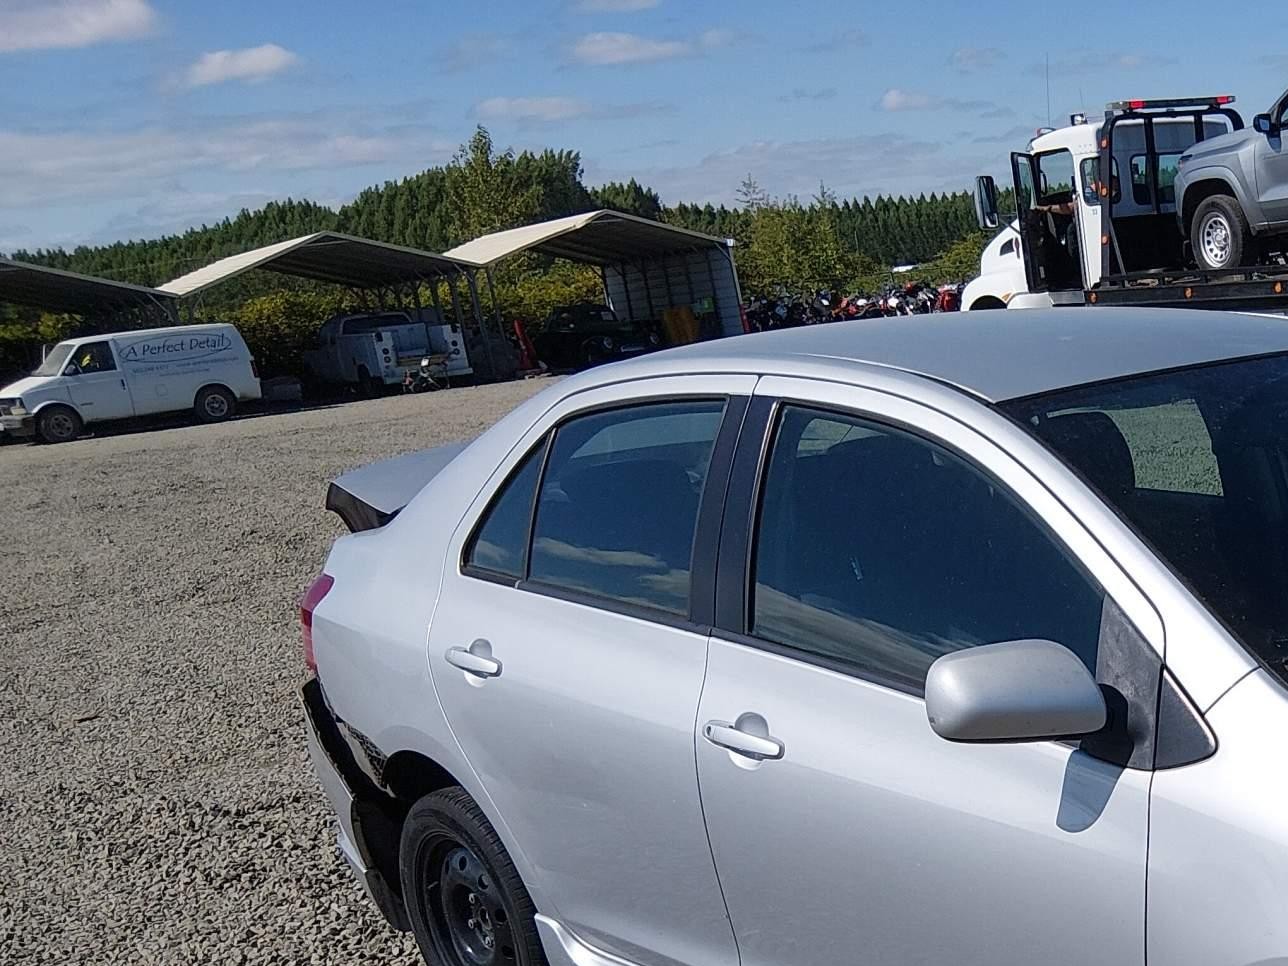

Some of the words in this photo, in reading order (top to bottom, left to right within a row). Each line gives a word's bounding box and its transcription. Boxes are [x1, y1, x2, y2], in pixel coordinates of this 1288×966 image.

[126, 346, 137, 359] A
[143, 339, 185, 355] Perfect
[190, 333, 224, 350] Detail
